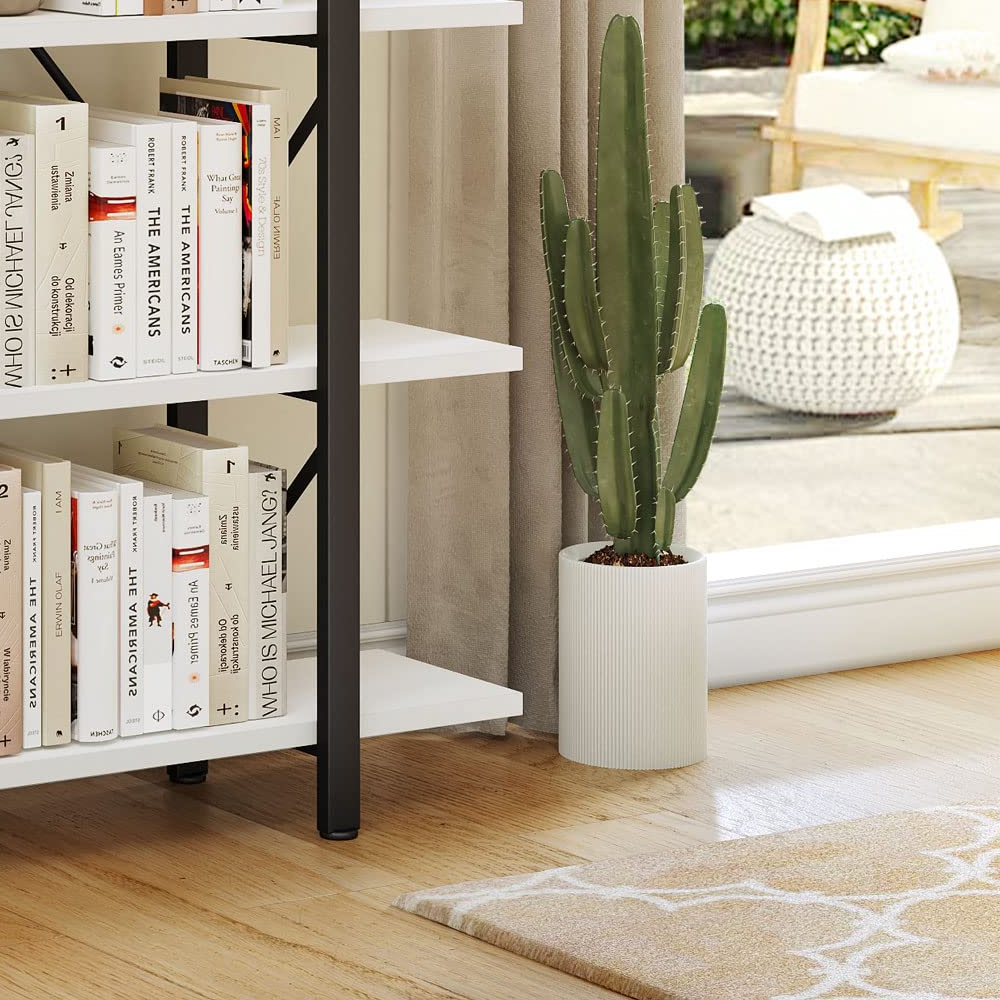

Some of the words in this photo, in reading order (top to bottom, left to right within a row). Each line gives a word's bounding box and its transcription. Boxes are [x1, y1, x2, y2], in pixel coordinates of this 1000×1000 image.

[55, 116, 66, 131] 1
[51, 165, 61, 211] ustawienia
[64, 171, 75, 203] Zmiana
[206, 173, 228, 182] What
[214, 207, 234, 215] Volume
[221, 195, 234, 205] Say
[148, 207, 161, 237] THE
[181, 204, 191, 235] THE
[113, 230, 125, 244] An
[113, 246, 125, 280] Eames
[51, 275, 61, 287] do
[65, 277, 75, 291] Od
[148, 243, 161, 338] AMERICANS
[181, 241, 191, 335] AMERICANS
[49, 288, 61, 337] konstrukcji
[63, 292, 75, 332] dekoracji
[113, 282, 126, 315] Primer
[213, 358, 239, 366] TASCHEN
[55, 490, 63, 508] AM
[261, 489, 278, 550] JANG?
[3, 539, 12, 571] Zmiana
[55, 572, 63, 600] OLAF
[261, 551, 278, 641] MICHAEL
[55, 602, 63, 638] ERWIN
[3, 647, 11, 658] W
[261, 643, 278, 662] IS
[2, 658, 11, 702] labiryncie
[261, 666, 278, 717] WHO
